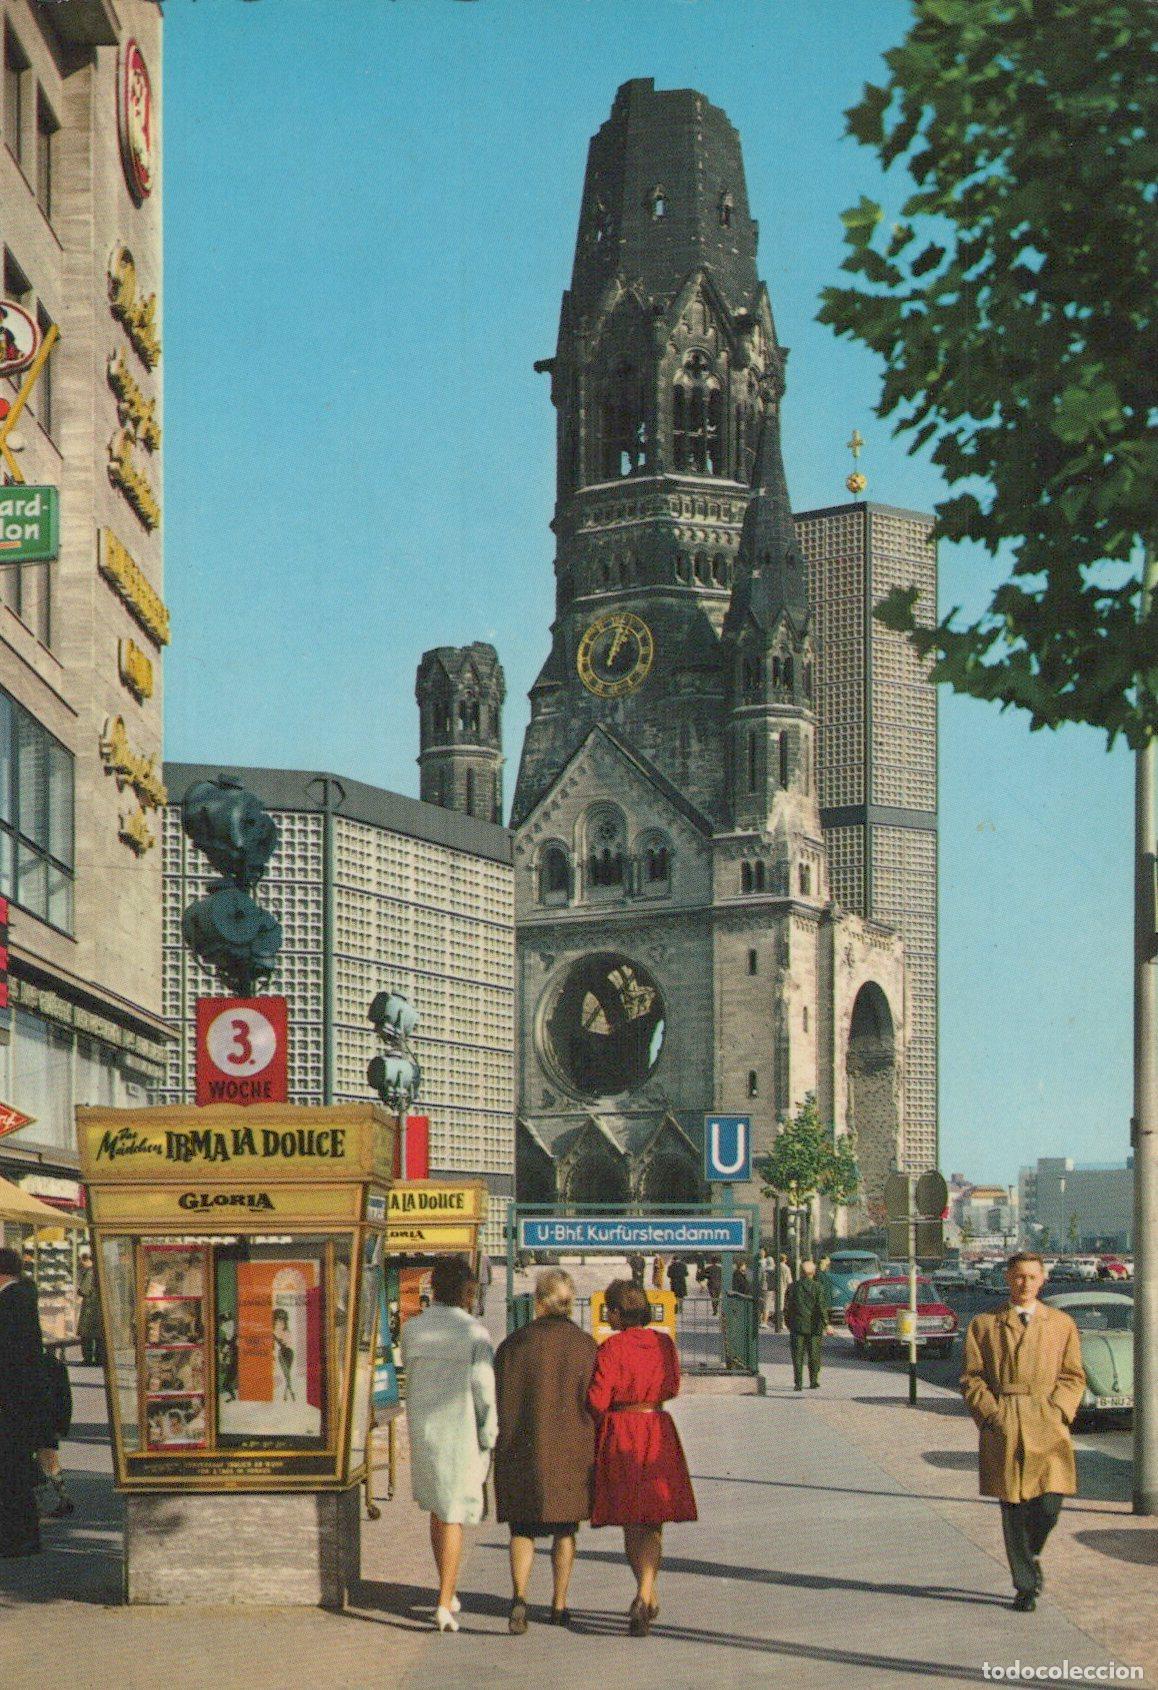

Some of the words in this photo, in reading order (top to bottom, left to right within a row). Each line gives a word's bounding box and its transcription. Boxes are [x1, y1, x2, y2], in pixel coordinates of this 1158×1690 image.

[226, 1019, 256, 1066] 3.
[208, 1080, 272, 1099] WOCHE
[165, 1129, 231, 1162] IRMA
[231, 1127, 258, 1156] LA
[261, 1129, 346, 1158] DOUCE
[711, 1123, 745, 1174] U
[178, 1192, 275, 1212] GLORIA
[418, 1193, 464, 1210] DOUCE
[388, 1230, 425, 1241] ORIA
[588, 1225, 731, 1242] Kurfürstendamm
